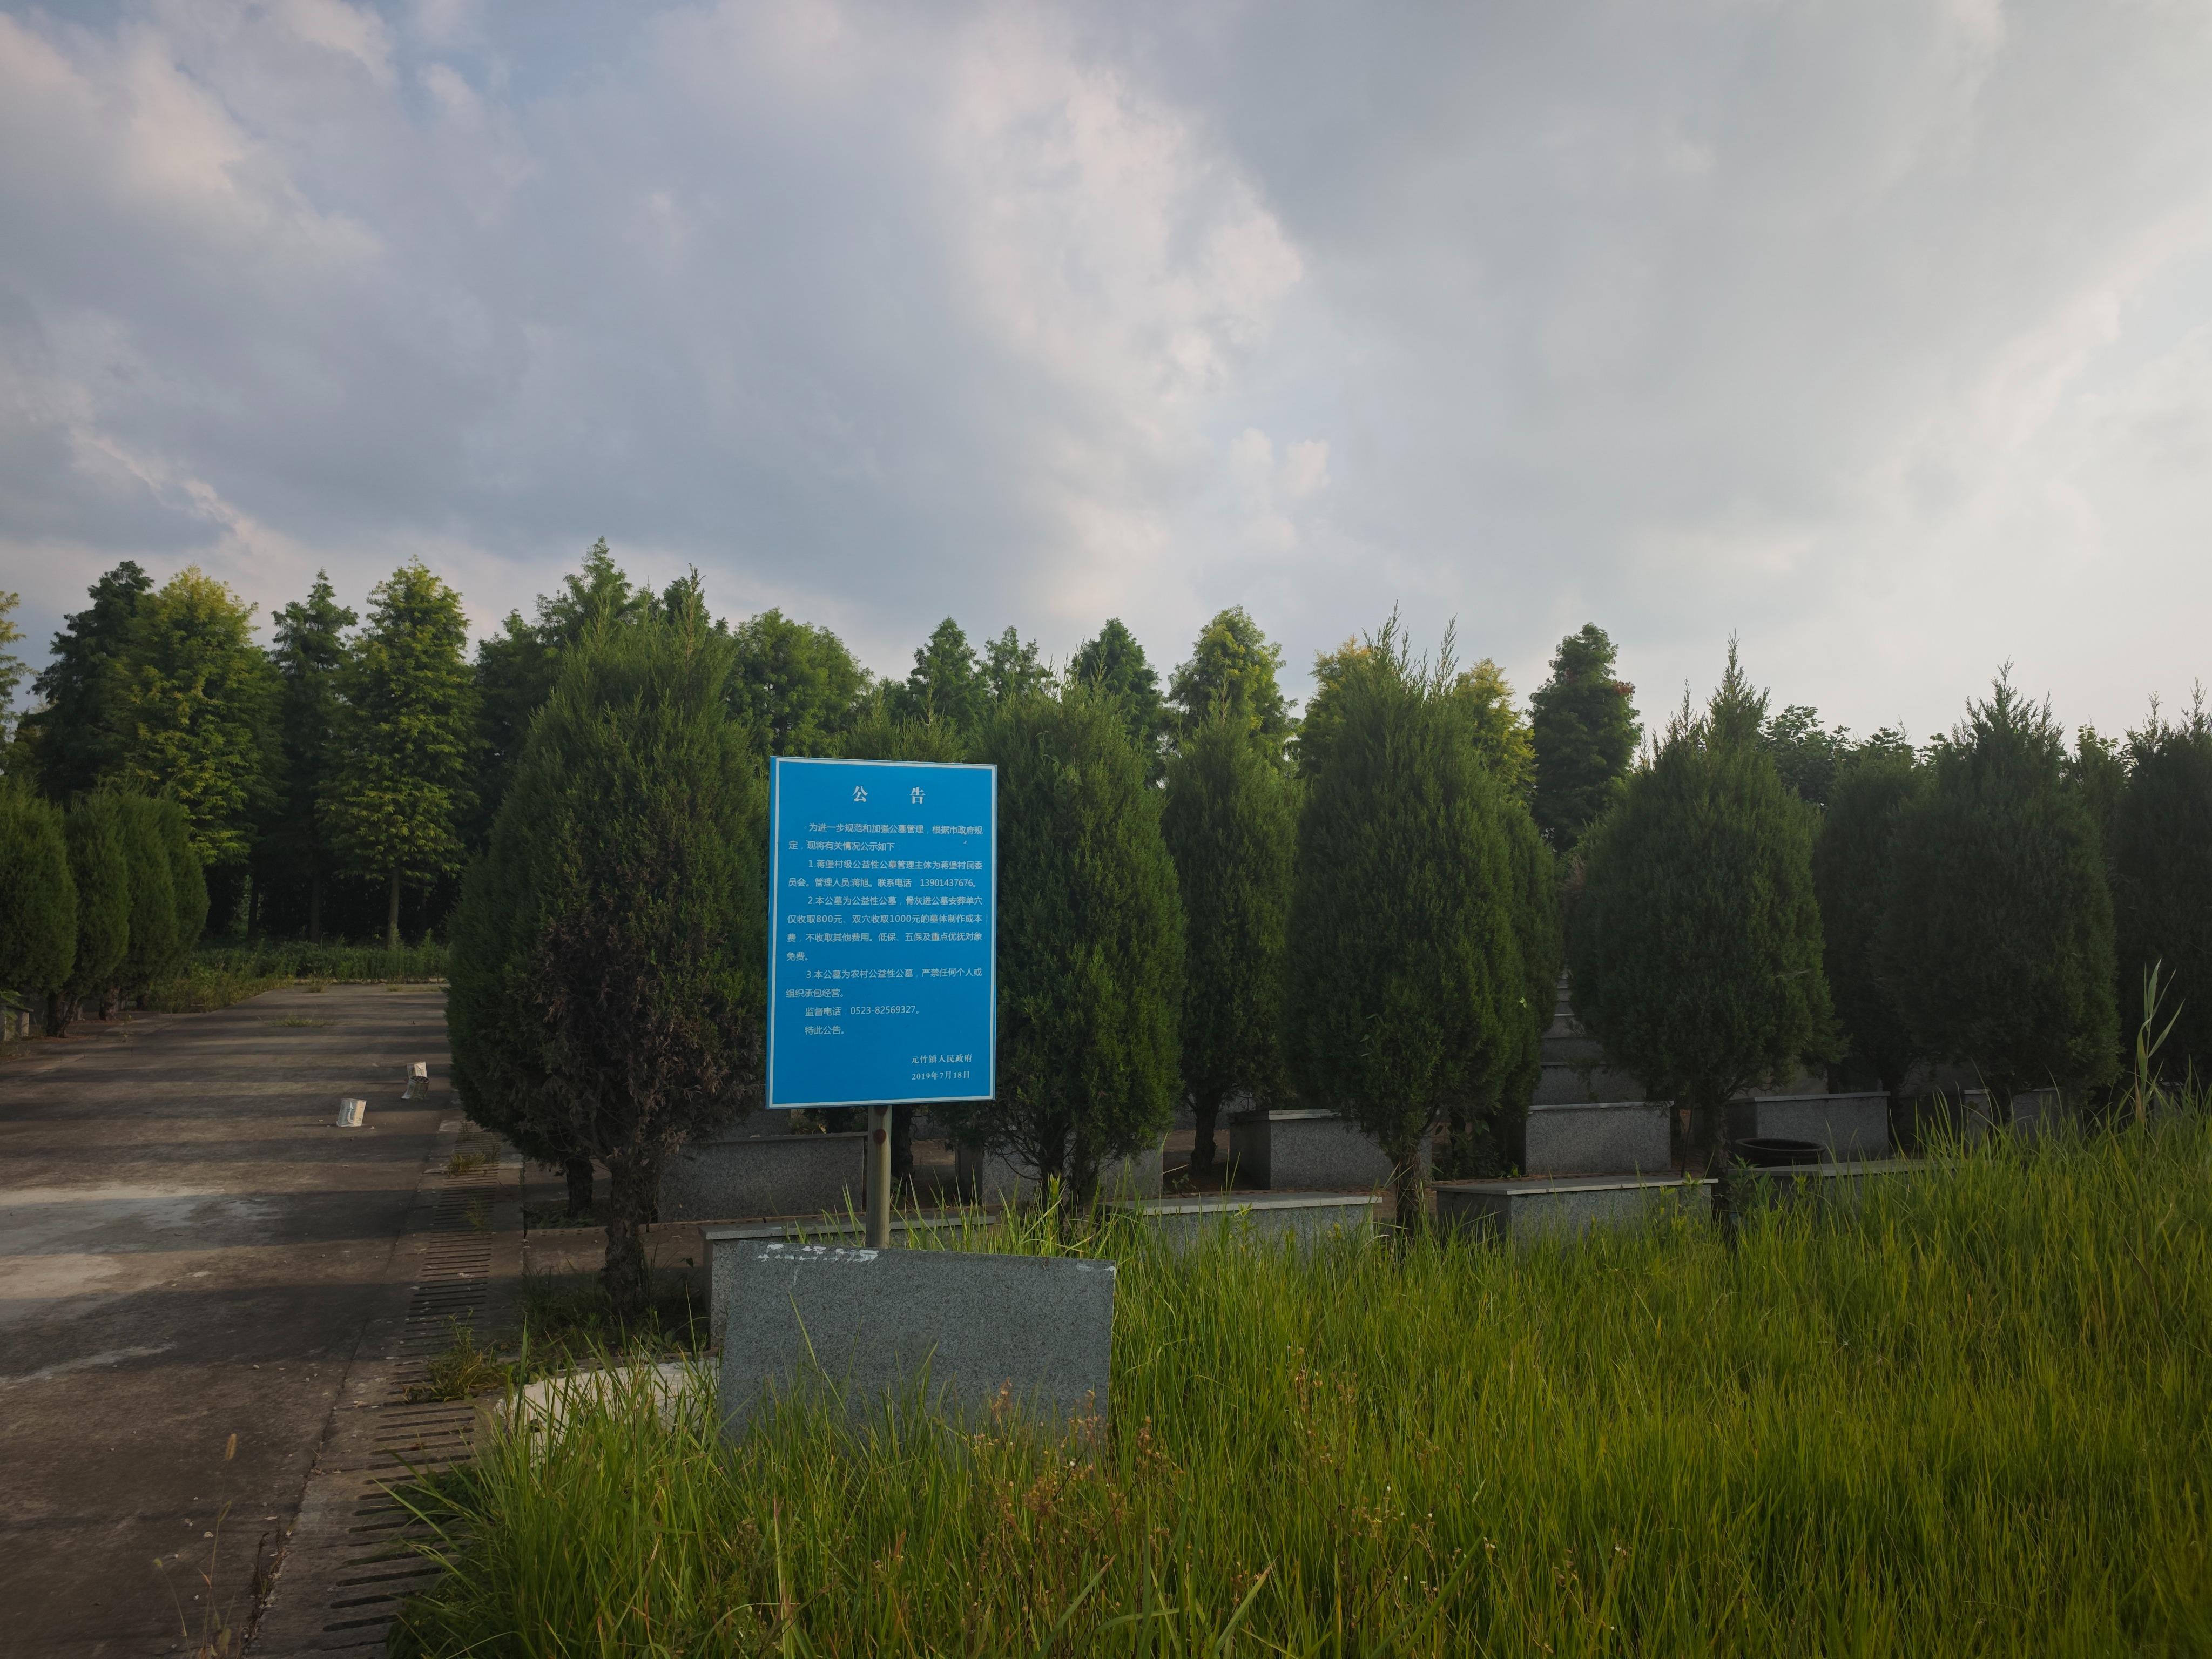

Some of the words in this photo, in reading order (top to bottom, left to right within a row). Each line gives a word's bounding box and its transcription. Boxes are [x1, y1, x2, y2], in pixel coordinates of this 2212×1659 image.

[804, 1024, 845, 1035] 特此公告。
[911, 1053, 973, 1064] 元竹镇人民政府
[912, 1070, 970, 1080] 2019年7月18日
